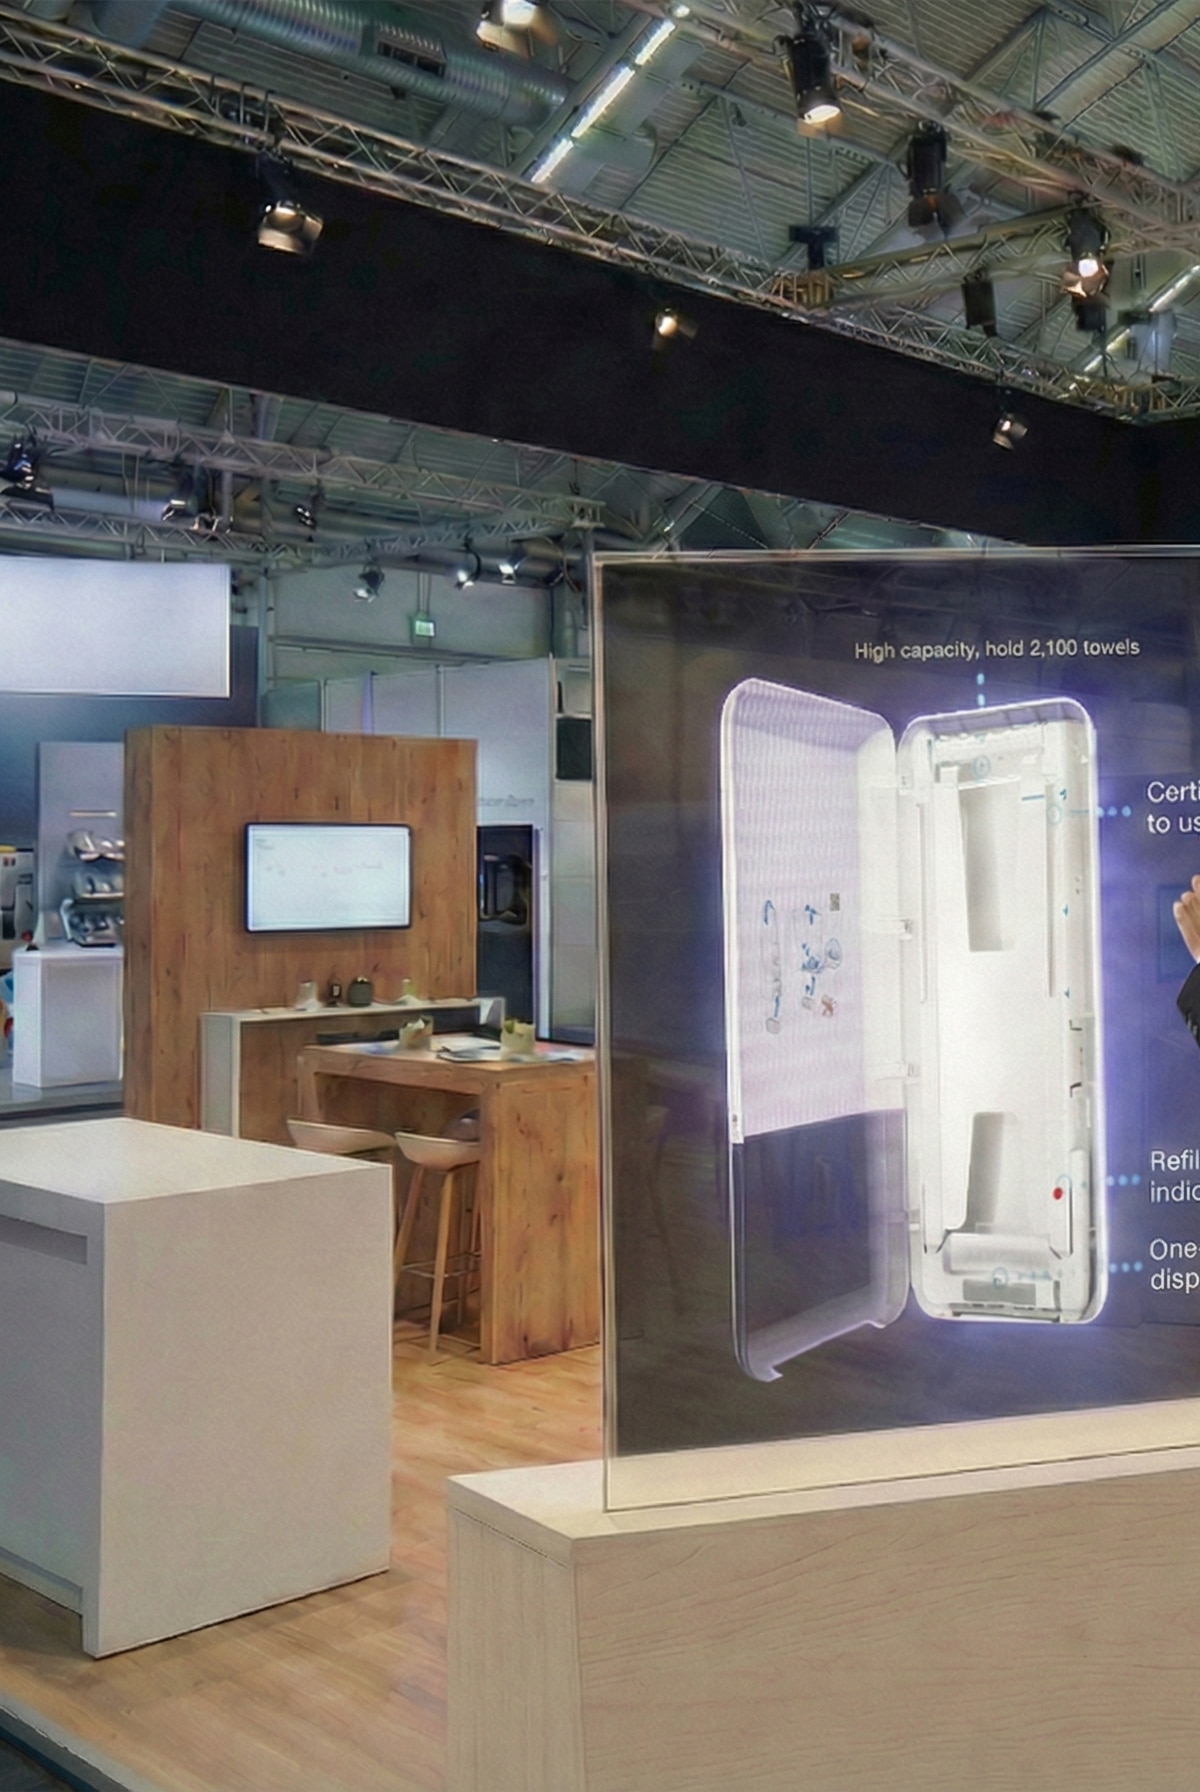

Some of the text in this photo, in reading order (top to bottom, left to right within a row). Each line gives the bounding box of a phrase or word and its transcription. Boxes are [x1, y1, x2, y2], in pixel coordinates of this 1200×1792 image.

[855, 638, 1141, 664] High capacity, hold 2,100 towels
[1146, 813, 1171, 834] to
